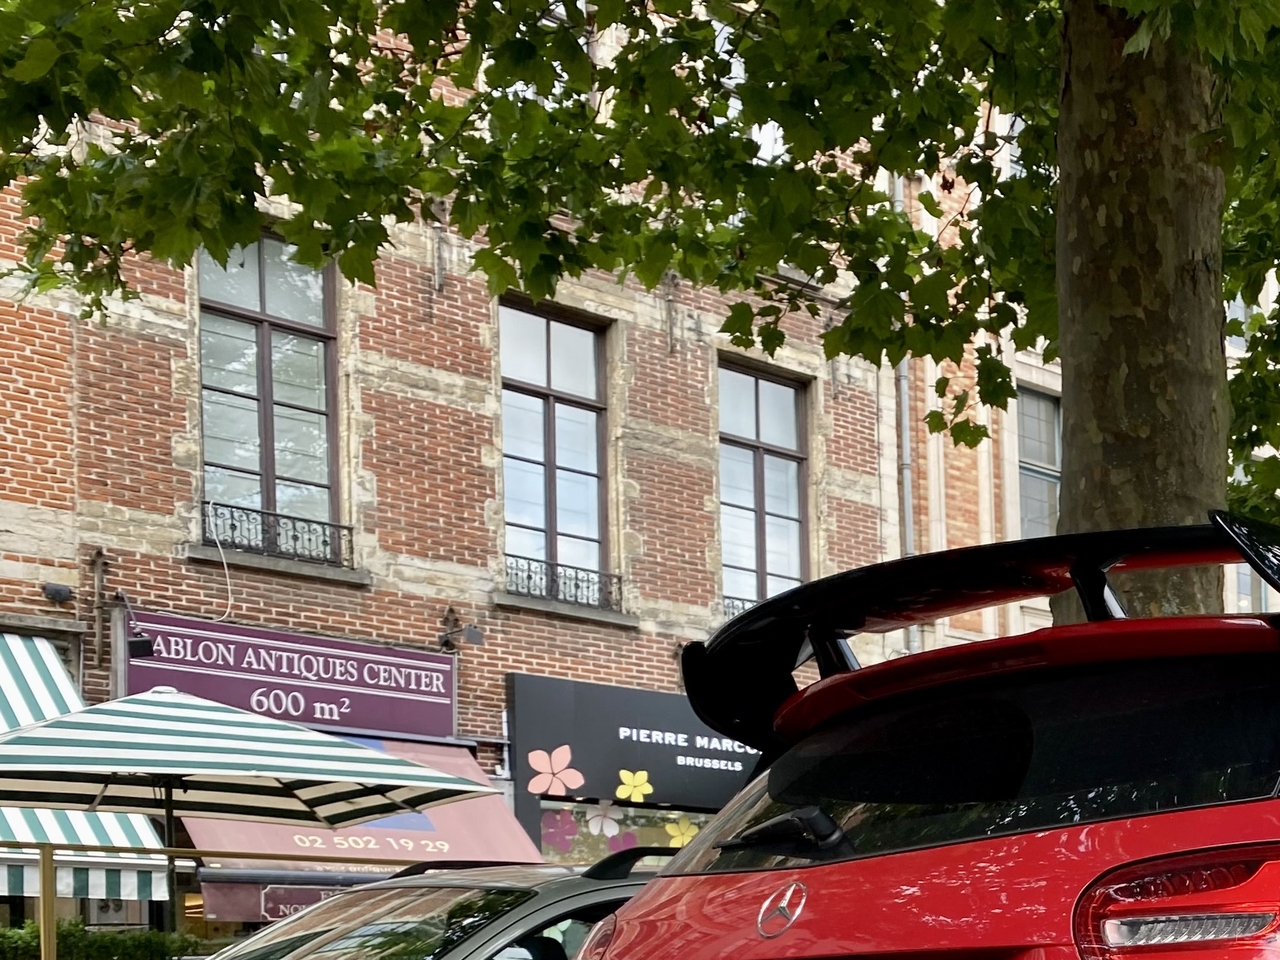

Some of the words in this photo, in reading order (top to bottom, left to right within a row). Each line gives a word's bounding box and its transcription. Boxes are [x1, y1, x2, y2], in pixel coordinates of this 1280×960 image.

[141, 633, 234, 666] ABLON
[241, 647, 358, 682] ANTIQUES
[363, 662, 445, 693] CENTER
[250, 687, 305, 717] 600
[313, 697, 351, 720] m²
[619, 727, 688, 747] PIERRE
[676, 755, 743, 771] BRUSSELS
[293, 834, 326, 848] 02
[333, 836, 380, 850] 502
[386, 837, 414, 851] 19
[421, 840, 449, 853] 29
